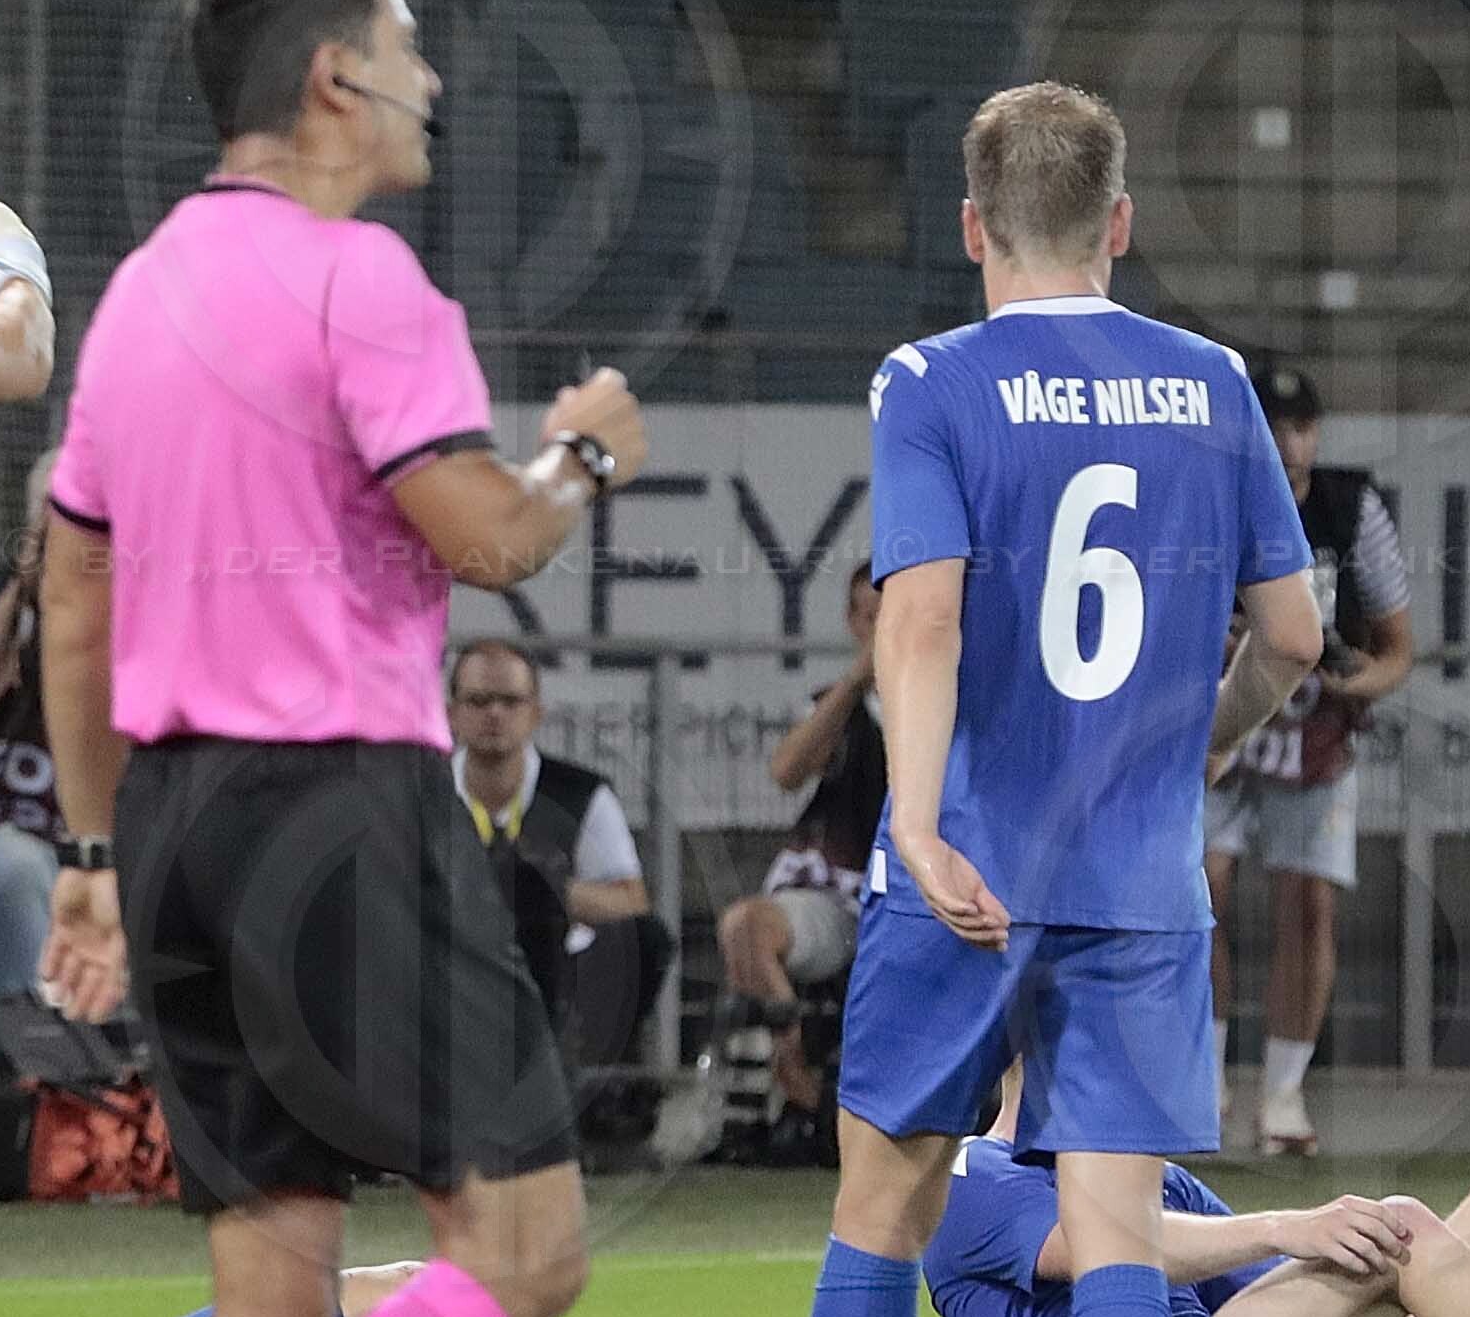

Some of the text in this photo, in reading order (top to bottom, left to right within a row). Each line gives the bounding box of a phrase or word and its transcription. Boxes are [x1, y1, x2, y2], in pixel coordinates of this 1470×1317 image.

[996, 369, 1211, 426] VÅGE NILSEN
[1039, 462, 1145, 702] 6
